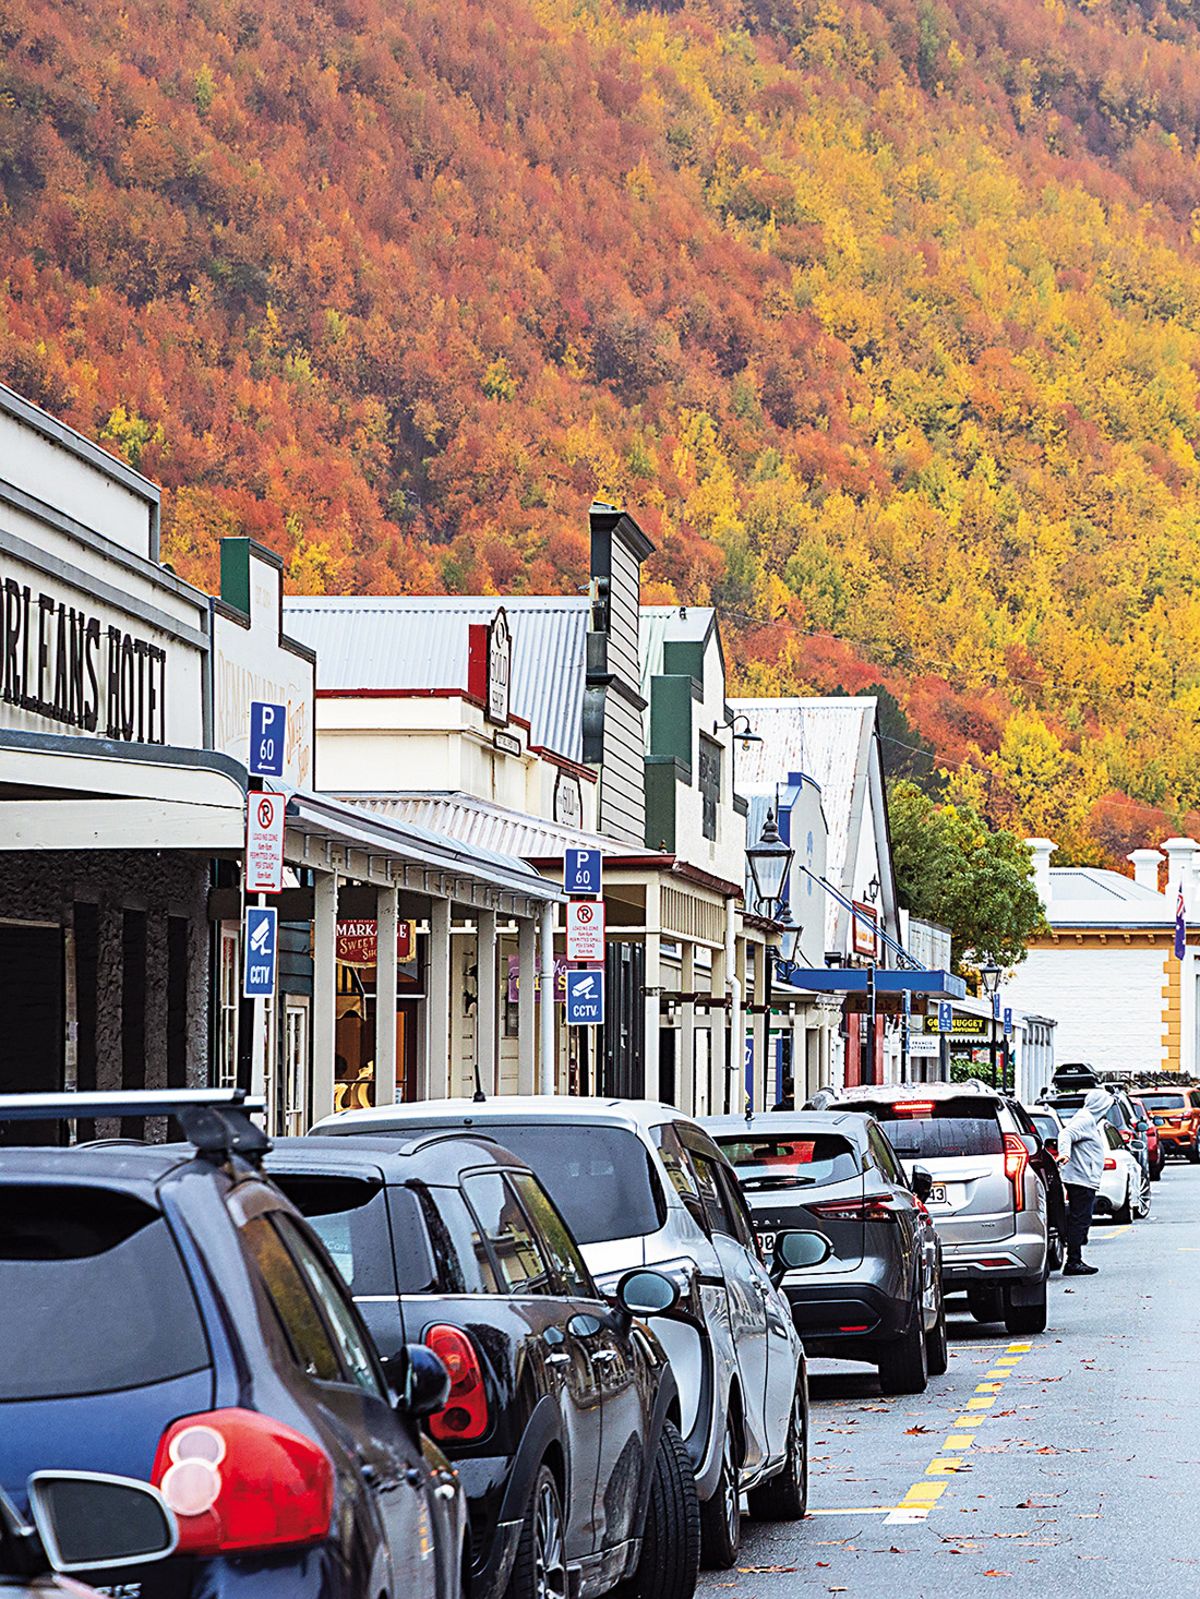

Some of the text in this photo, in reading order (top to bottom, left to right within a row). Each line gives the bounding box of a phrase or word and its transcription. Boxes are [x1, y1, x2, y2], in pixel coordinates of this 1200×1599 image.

[0, 577, 100, 733] RLEANS
[261, 706, 275, 735] P
[260, 738, 275, 761] 60
[576, 851, 590, 869] P
[575, 870, 590, 884] 60
[250, 965, 270, 985] CCTV
[573, 1005, 597, 1017] CCTV
